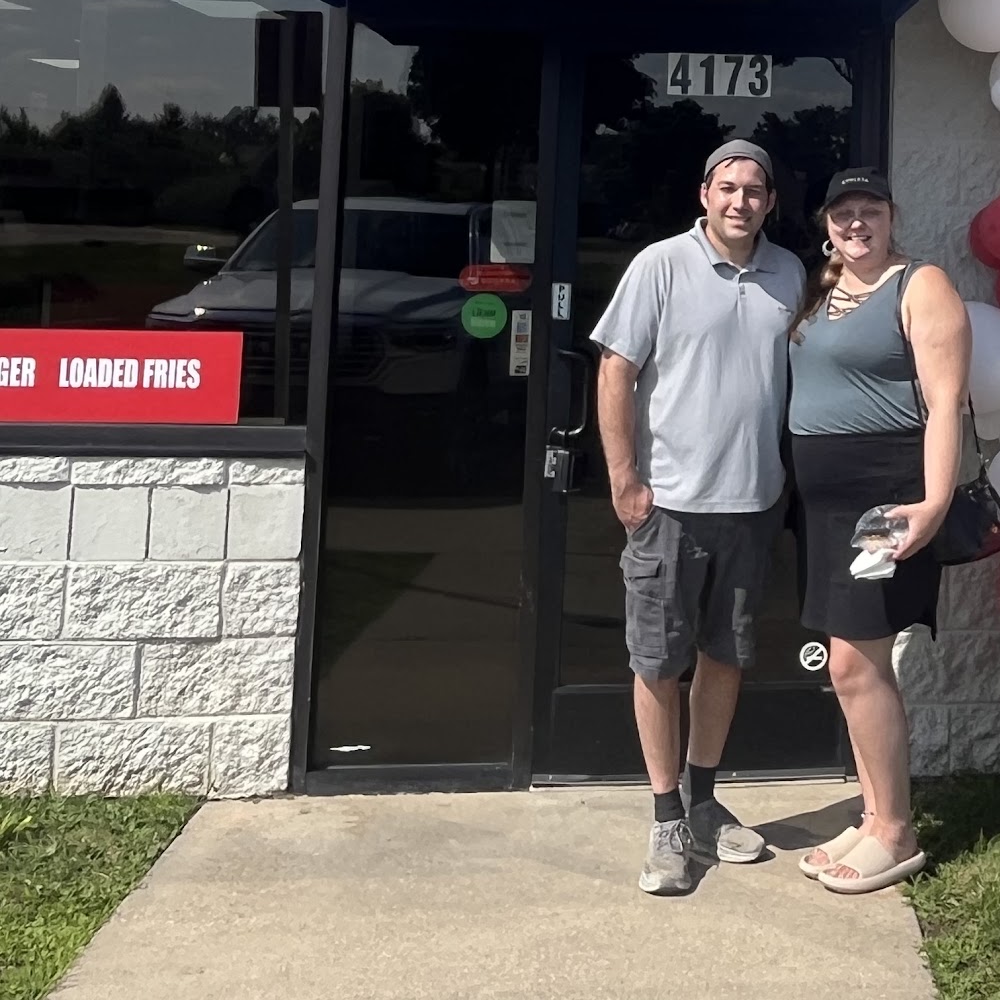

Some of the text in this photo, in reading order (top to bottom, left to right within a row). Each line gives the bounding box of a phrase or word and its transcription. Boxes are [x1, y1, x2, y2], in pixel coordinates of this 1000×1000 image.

[670, 54, 768, 96] 4173
[557, 284, 566, 318] PULL
[58, 357, 138, 389] LOADED
[142, 358, 201, 390] FRIES
